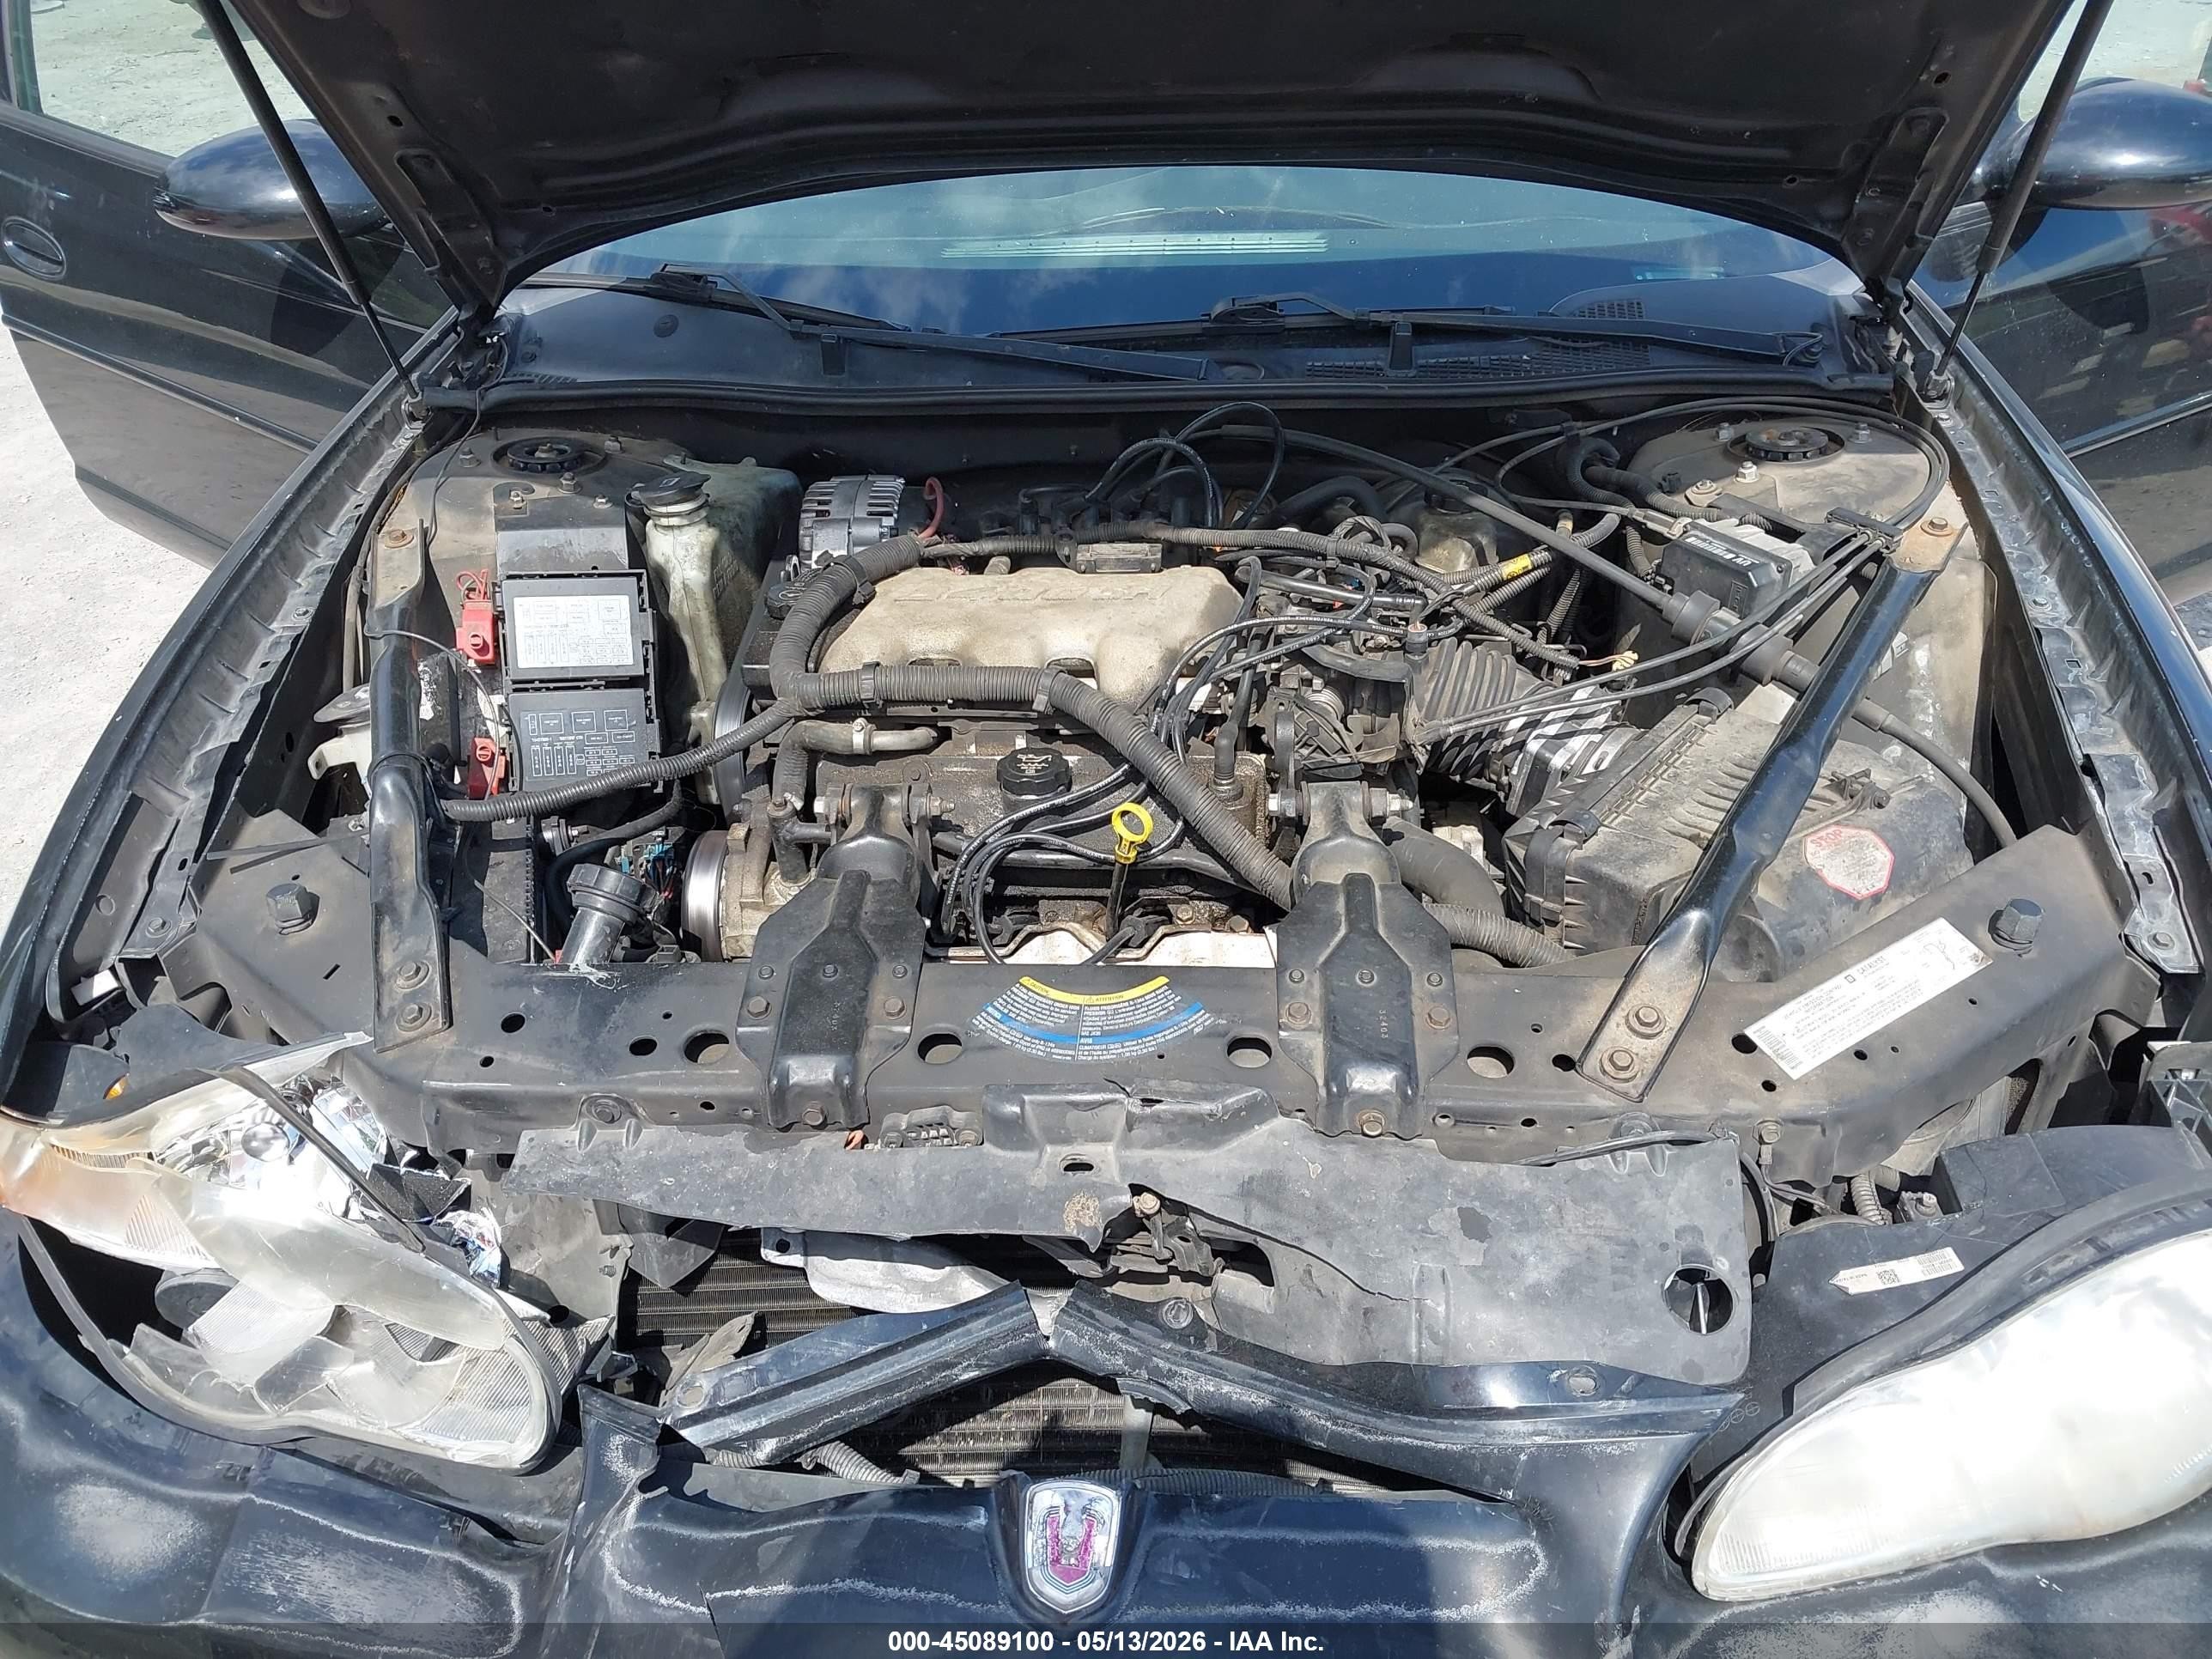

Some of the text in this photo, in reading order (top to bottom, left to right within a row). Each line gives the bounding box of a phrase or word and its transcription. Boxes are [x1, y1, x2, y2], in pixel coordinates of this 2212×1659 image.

[1371, 624, 1405, 635] SUPPRESSION
[1809, 829, 1843, 848] STOP
[1856, 956, 1887, 975] CATALYST
[1030, 981, 1049, 994] CAUTION
[1095, 994, 1124, 1003] ATTENTION
